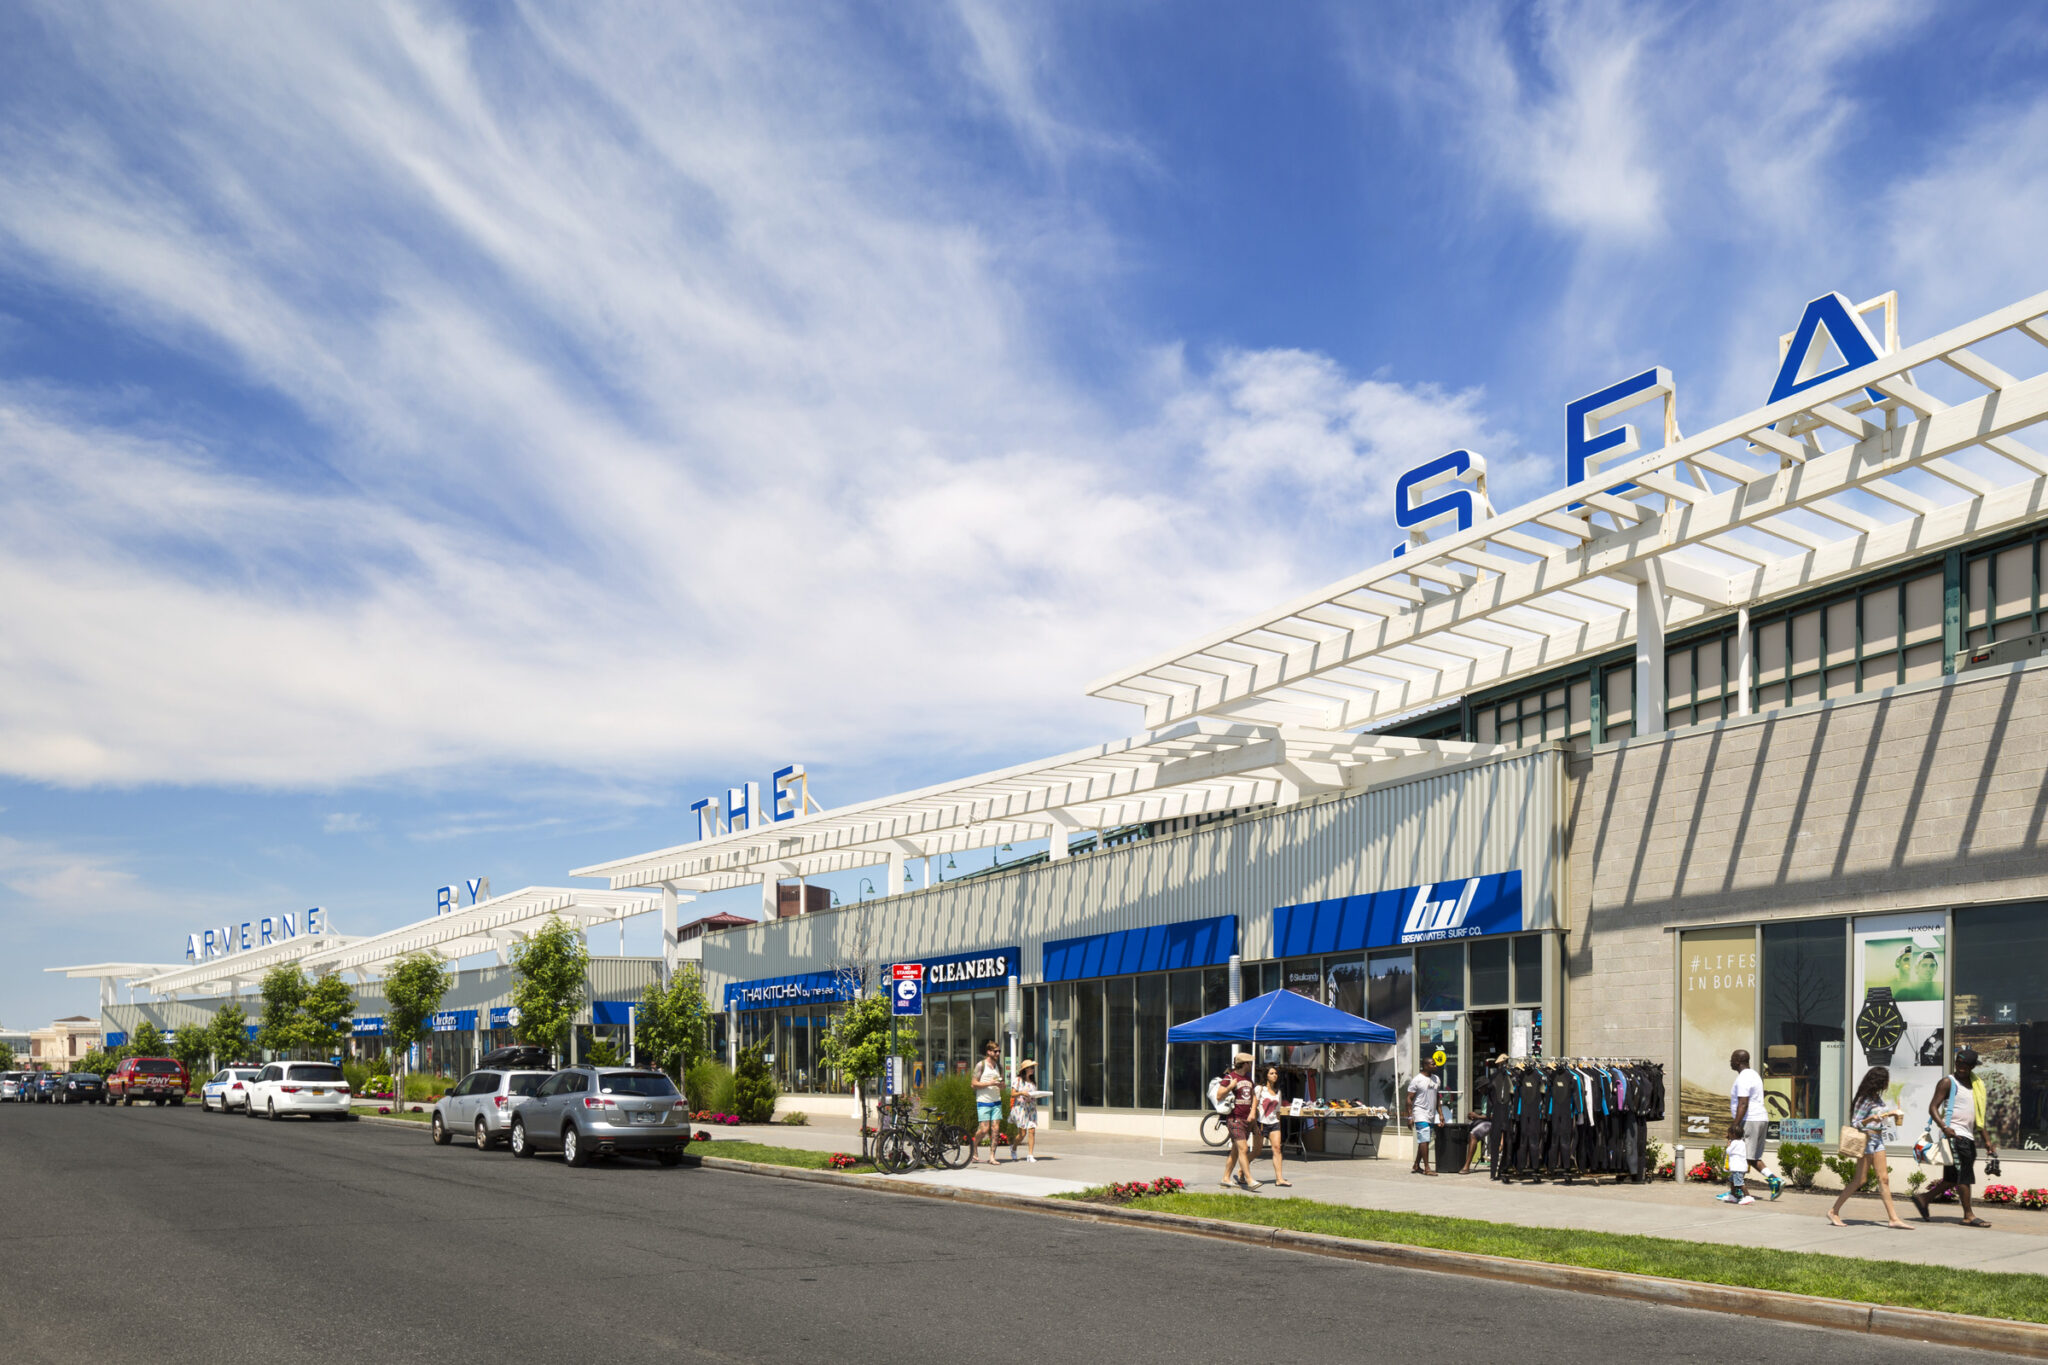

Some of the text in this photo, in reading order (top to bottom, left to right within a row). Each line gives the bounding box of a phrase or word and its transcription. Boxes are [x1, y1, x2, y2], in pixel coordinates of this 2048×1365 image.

[186, 907, 321, 960] ARVERNE
[690, 764, 797, 841] THE
[1393, 291, 1893, 560] SEA
[1401, 931, 1446, 944] BREAKWATER
[1448, 927, 1468, 938] SURF
[1907, 925, 1934, 933] NIXON
[930, 956, 1006, 984] CLEANERS
[1689, 953, 1756, 973] #LIFES
[1688, 973, 1755, 991] IN BOAR
[741, 987, 762, 1002] THAI
[763, 983, 802, 1001] KITCHEN
[146, 1075, 170, 1085] FDNY
